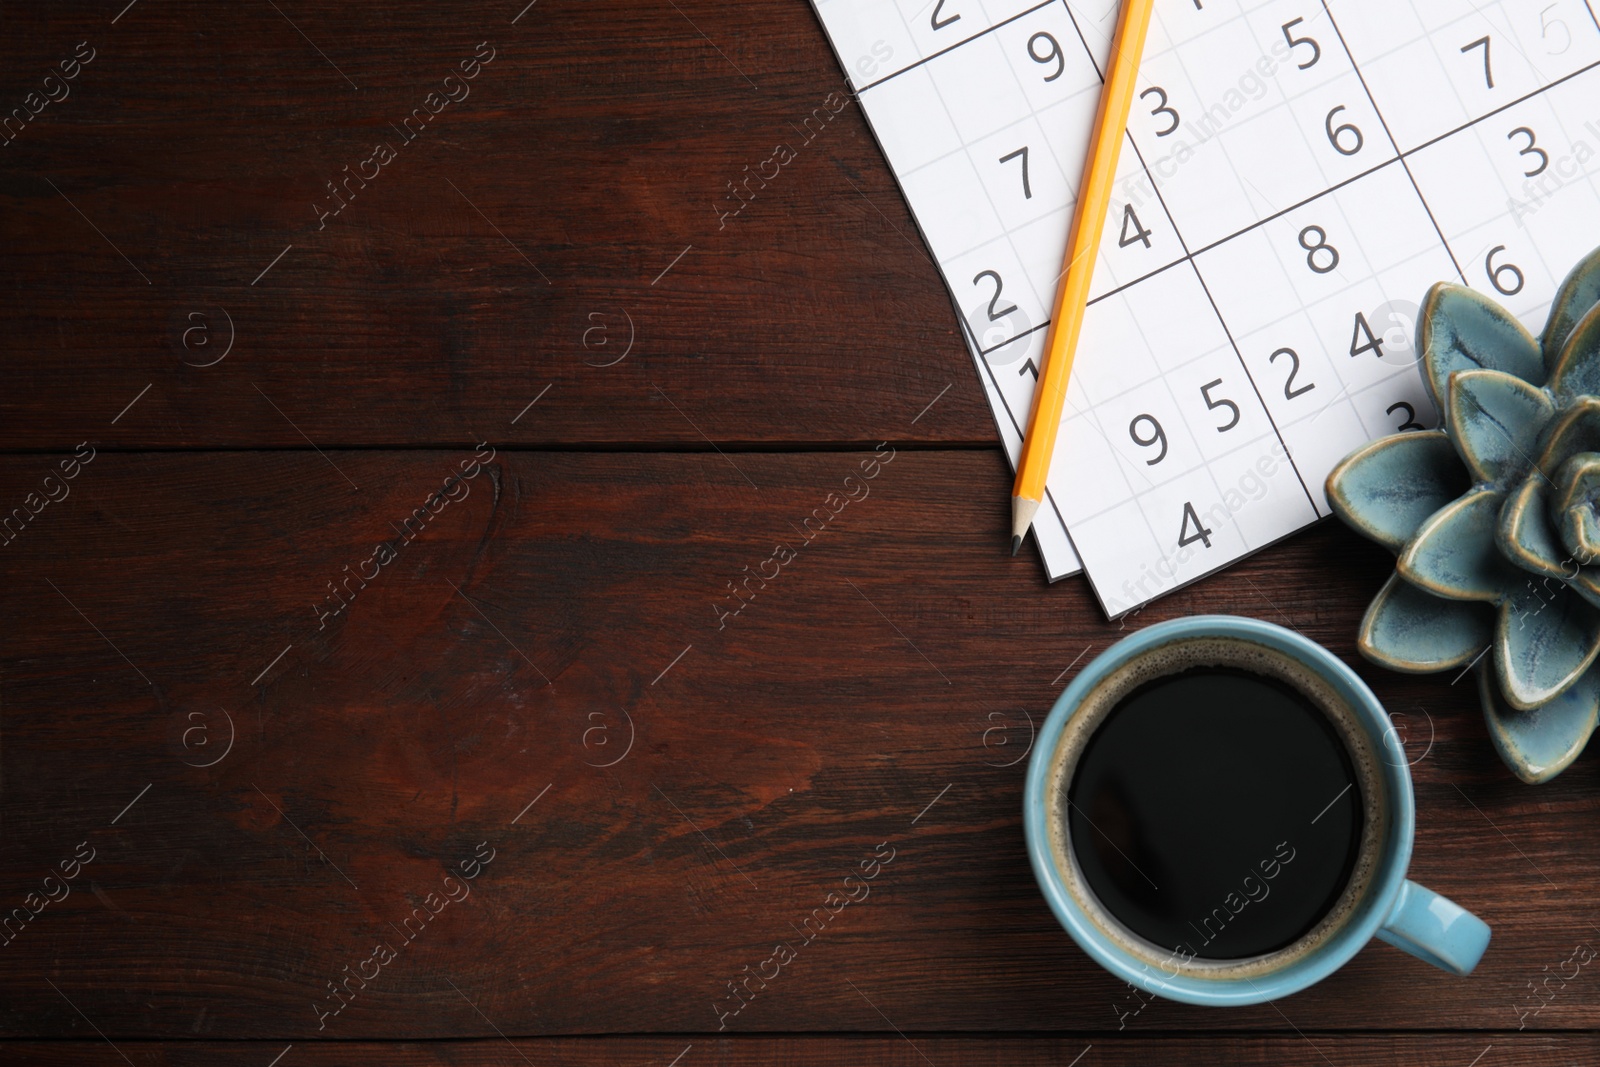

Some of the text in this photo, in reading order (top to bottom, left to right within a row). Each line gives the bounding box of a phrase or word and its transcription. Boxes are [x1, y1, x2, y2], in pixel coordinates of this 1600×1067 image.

[930, 0, 961, 31] 2
[1027, 31, 1065, 83] 9
[1539, 2, 1573, 57] 5
[972, 35, 1495, 322] 2 4 6 7
[998, 16, 1321, 200] 7 3 5
[1298, 225, 1340, 274] 8
[1507, 126, 1549, 178] 3
[1129, 245, 1525, 466] 9 5 2 4 6
[1177, 401, 1426, 549] 4 3
